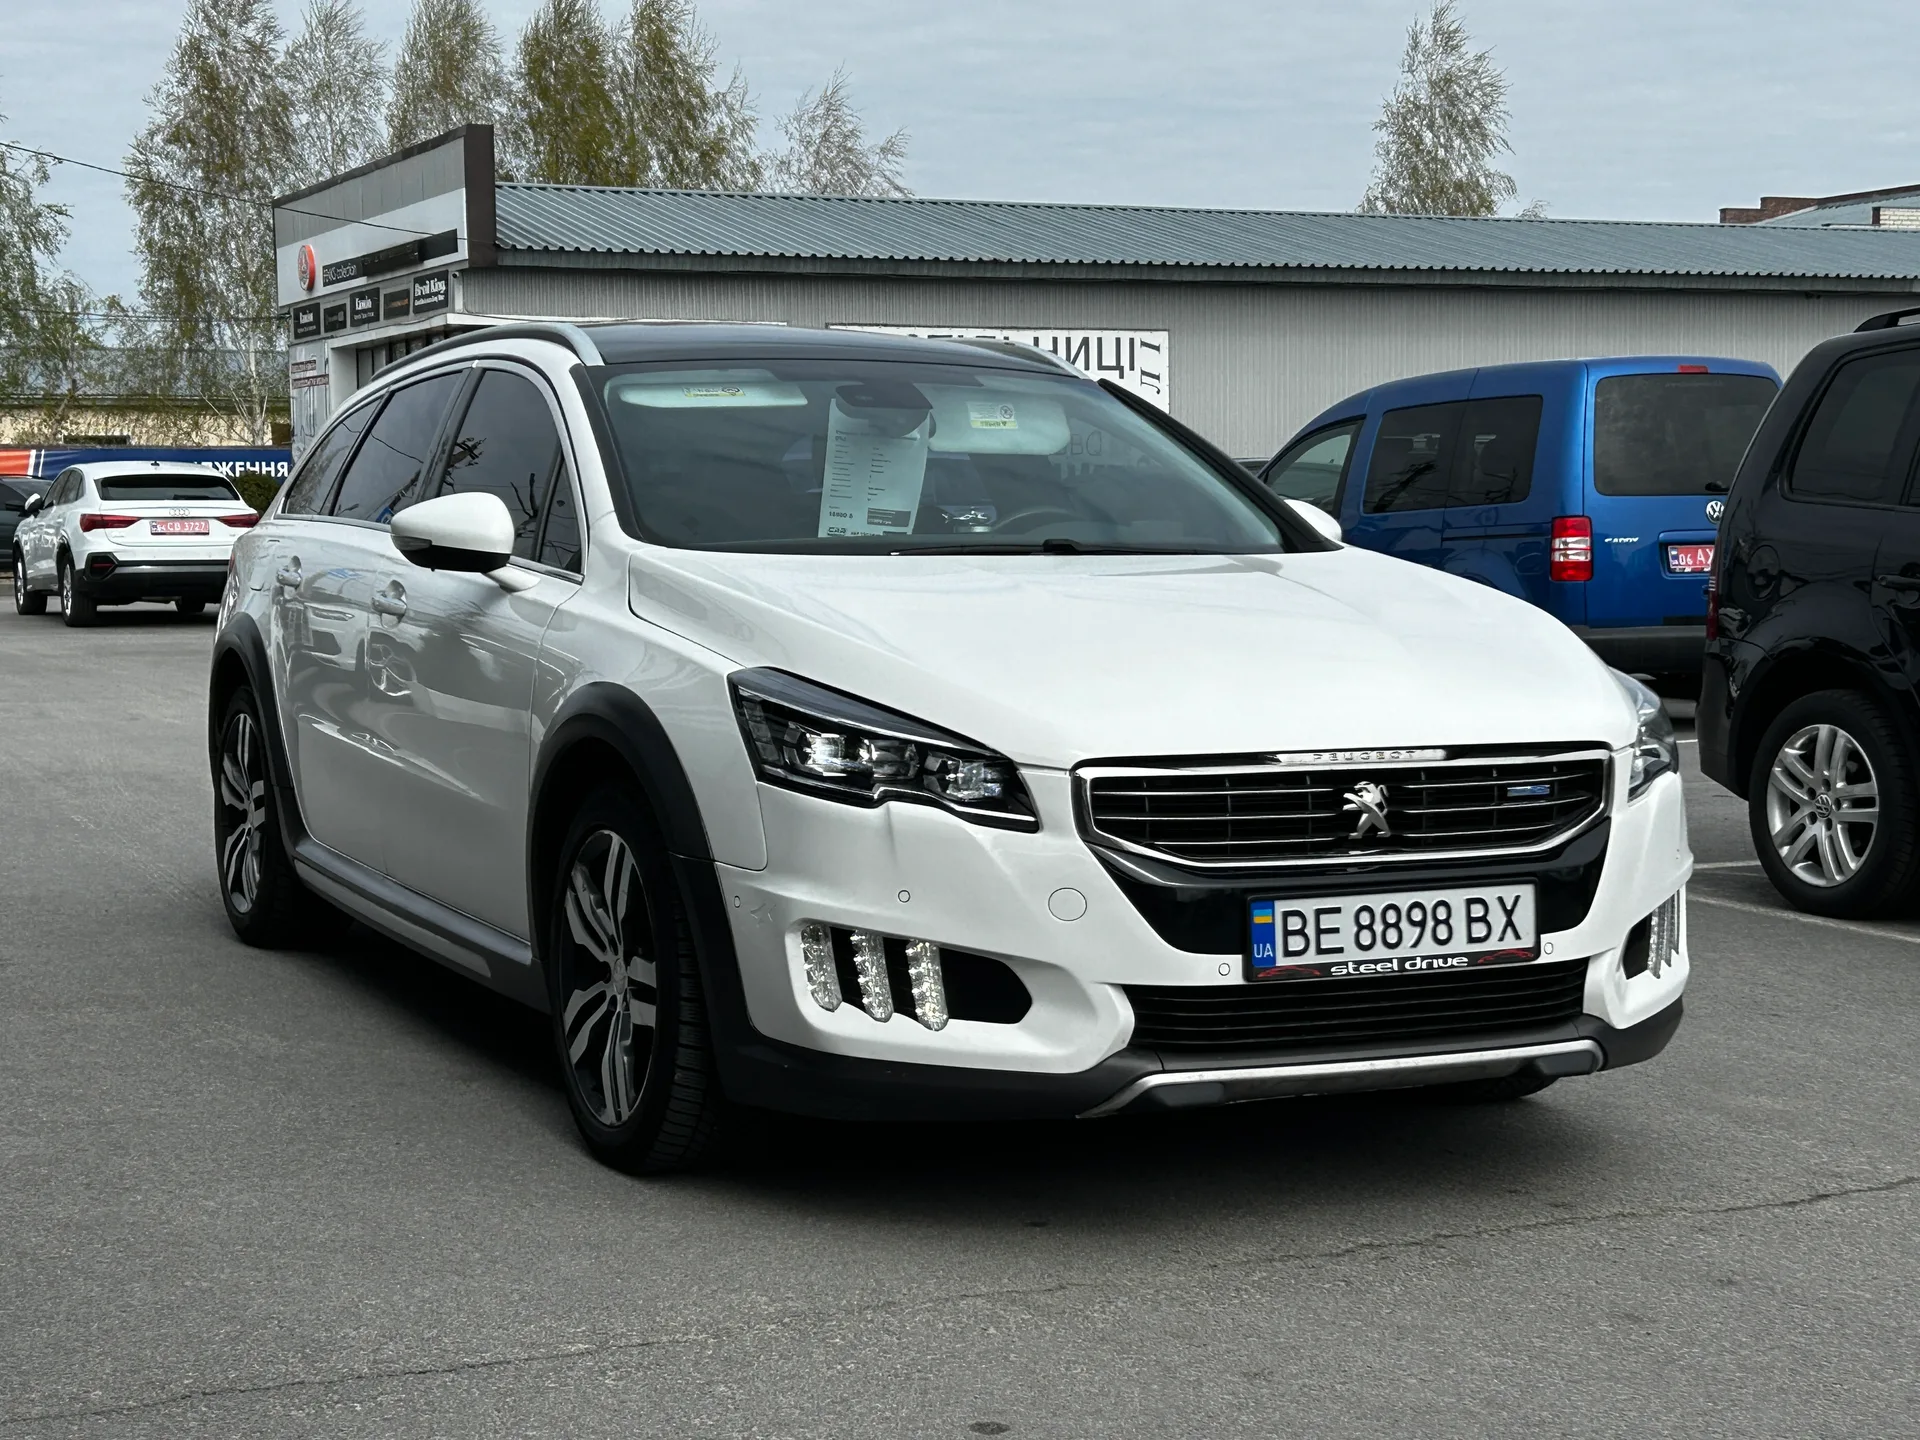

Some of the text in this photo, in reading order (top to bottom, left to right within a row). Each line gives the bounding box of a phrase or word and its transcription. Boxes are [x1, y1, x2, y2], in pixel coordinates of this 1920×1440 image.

[1312, 750, 1416, 763] PEUGEOT
[1280, 894, 1523, 958] BE 8898 BX
[1253, 943, 1274, 958] UA
[1330, 955, 1469, 976] steel drive
